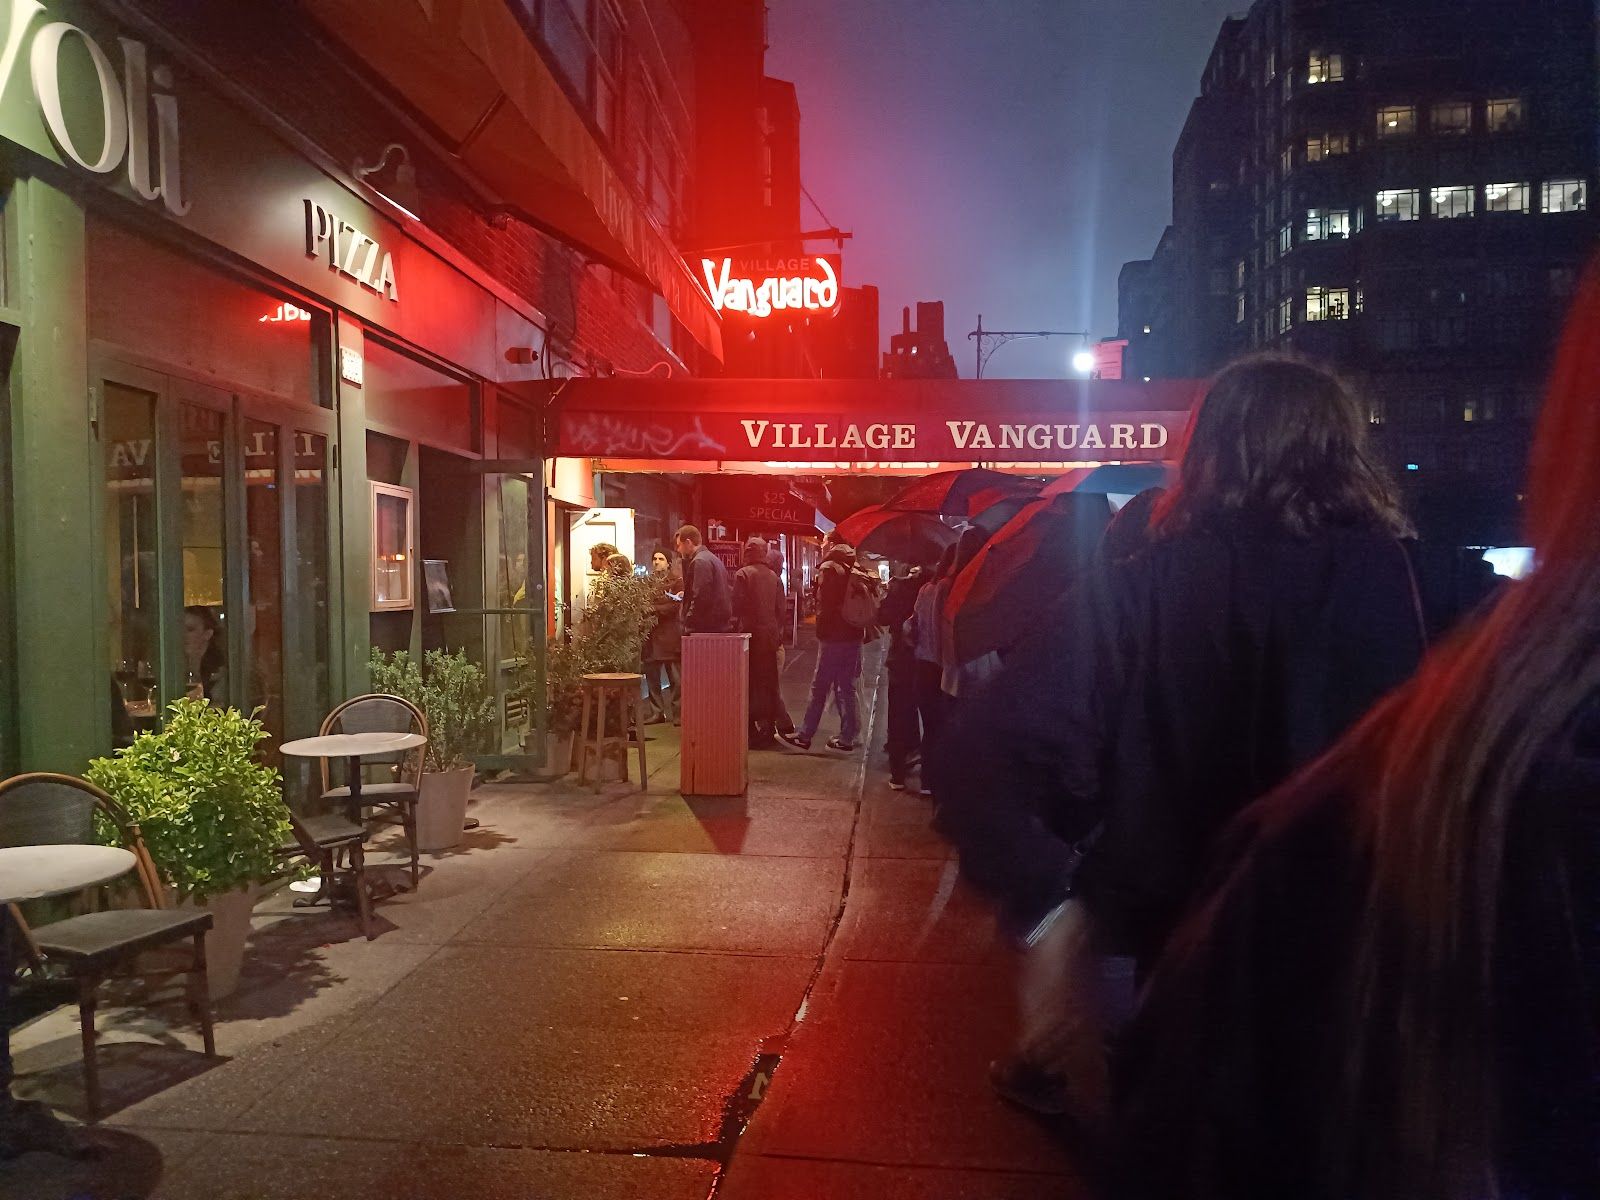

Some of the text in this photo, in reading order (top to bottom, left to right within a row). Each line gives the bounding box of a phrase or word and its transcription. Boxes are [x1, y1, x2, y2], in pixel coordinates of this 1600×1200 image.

[303, 198, 399, 301] PIZZA
[740, 258, 809, 272] VILLAGE
[701, 257, 838, 318] Vanguard
[741, 419, 917, 450] VILLAGE
[946, 419, 1168, 450] VANGUARD
[764, 492, 785, 504] $25
[750, 506, 798, 522] SPECIAL
